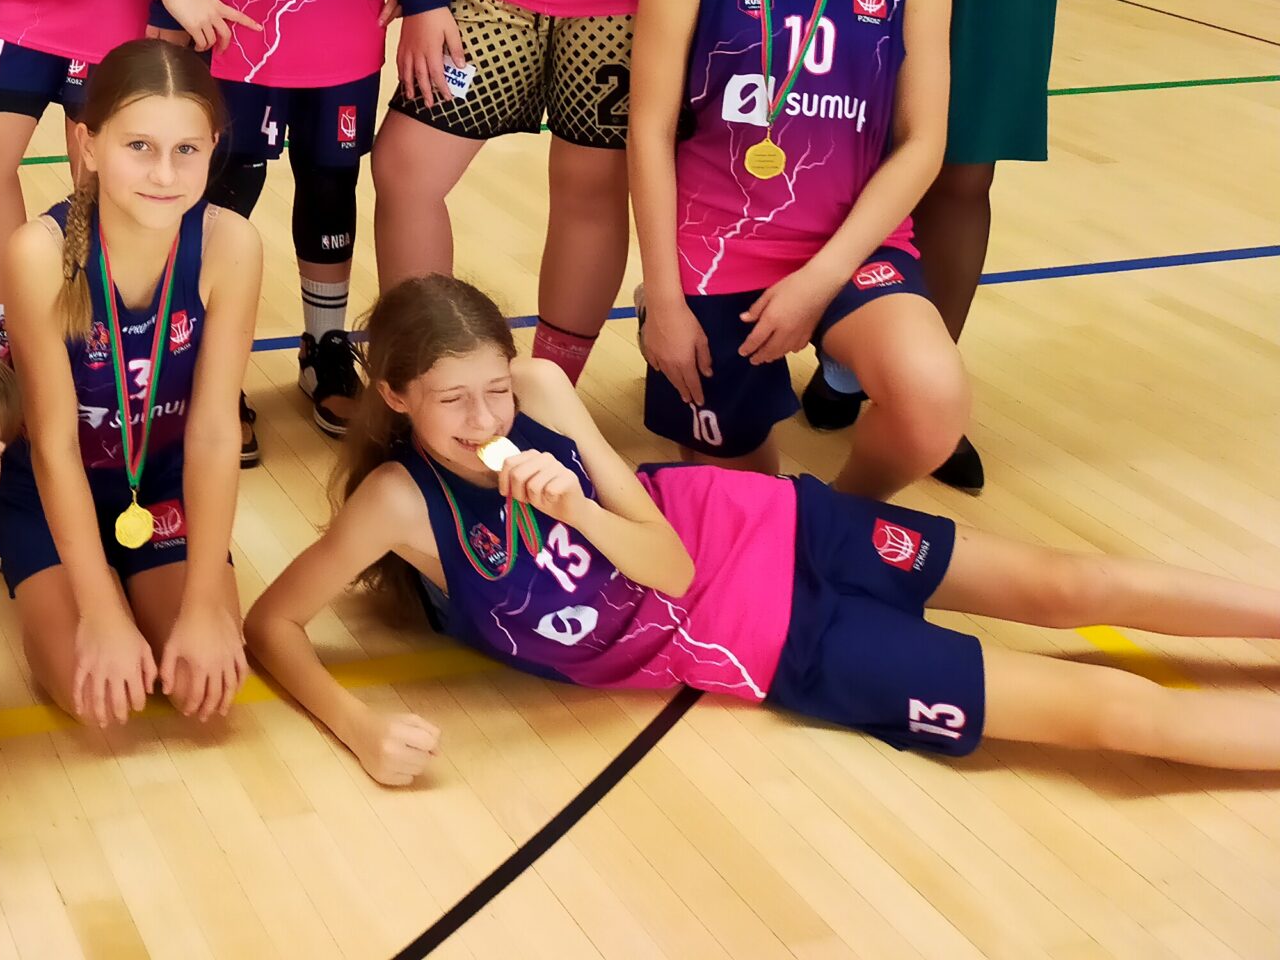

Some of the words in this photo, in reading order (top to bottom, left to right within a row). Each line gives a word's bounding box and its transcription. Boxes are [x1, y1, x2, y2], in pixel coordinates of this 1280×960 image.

[785, 14, 836, 75] 10
[593, 62, 631, 129] 2
[261, 105, 278, 146] 4
[331, 232, 350, 250] NBA
[689, 402, 723, 446] 10
[536, 522, 592, 593] 13
[908, 697, 966, 741] 13
